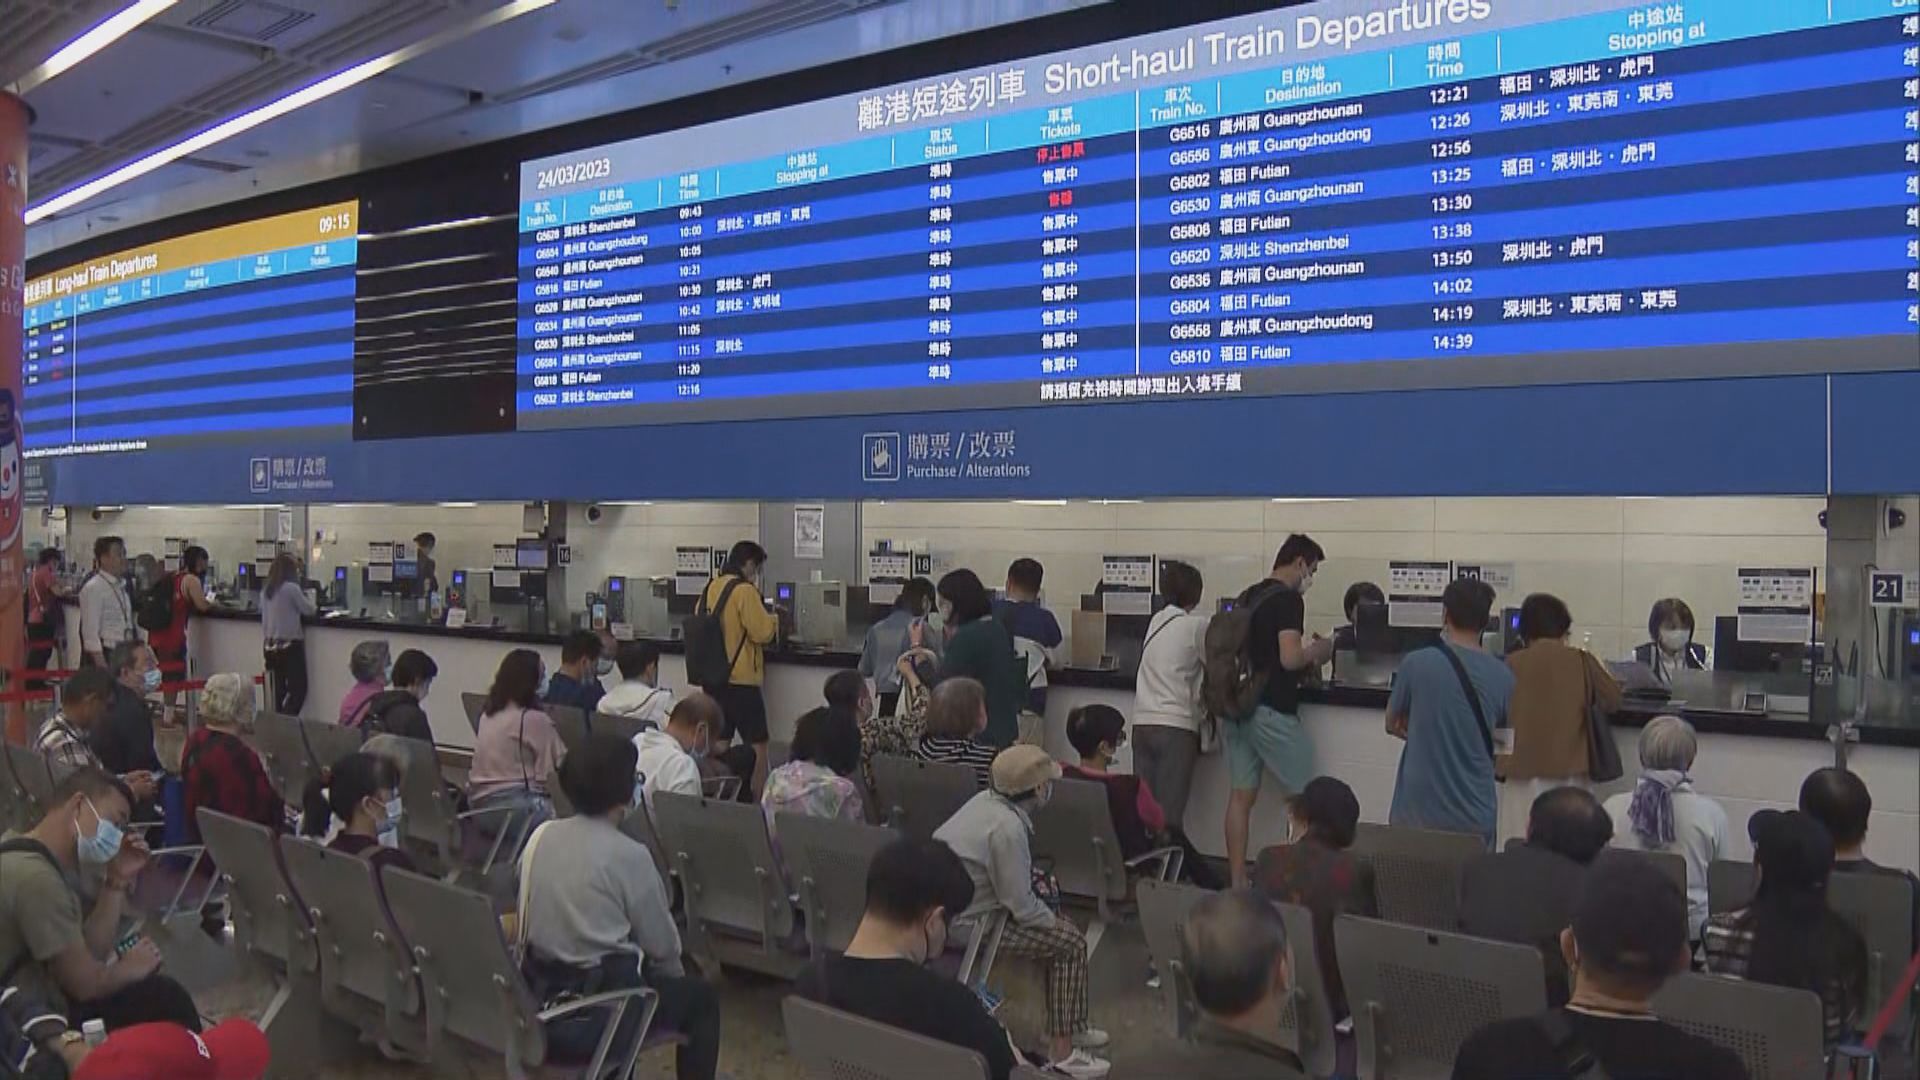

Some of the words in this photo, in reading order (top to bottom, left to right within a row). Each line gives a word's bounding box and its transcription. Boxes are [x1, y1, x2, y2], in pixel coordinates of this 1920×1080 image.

[1628, 5, 1684, 29] 中途站
[1609, 26, 1682, 51] Stopping
[1689, 21, 1705, 38] at
[1045, 39, 1193, 93] Short-haul
[1204, 26, 1284, 64] Train
[1297, 0, 1490, 49] Departures
[1428, 42, 1461, 61] 時間
[1282, 64, 1325, 85] 目的地
[1427, 62, 1464, 79] Time
[857, 69, 1026, 131] 離港短途列車
[1165, 86, 1192, 103] 車次
[1265, 81, 1341, 104] Destination
[1430, 86, 1468, 104] 12:21
[1048, 107, 1073, 123] 車票
[1151, 106, 1181, 121] Train
[1185, 102, 1206, 116] No.
[1219, 114, 1260, 136] 廣州南
[1264, 102, 1363, 128] Guangzhounan
[1431, 112, 1471, 130] 12:26
[1040, 124, 1080, 139] Tickets
[924, 145, 957, 158] Status
[1219, 140, 1260, 160] 廣州東
[1264, 127, 1371, 152] Guangzhoudong
[1431, 140, 1471, 158] 12:56
[538, 159, 610, 189] 24/03/2023
[777, 166, 816, 184] Stopping
[819, 164, 828, 177] at
[930, 162, 952, 179] 準時
[1043, 166, 1078, 185] 售票中
[1219, 167, 1247, 185] 福田
[1250, 164, 1290, 181] Futian
[1431, 168, 1471, 184] 13:25
[1170, 173, 1210, 191] G5802
[679, 188, 699, 200] Time
[930, 184, 952, 201] 準時
[1219, 190, 1260, 209] 廣州南
[1264, 181, 1364, 203] Guangzhounan
[590, 201, 633, 215] Destination
[1170, 198, 1210, 215] G6530
[1431, 194, 1472, 212] 13:30
[680, 205, 702, 219] 09:43
[930, 207, 952, 224] 準時
[319, 214, 349, 233] 09:15
[588, 216, 636, 233] Shenzhenbei
[1042, 213, 1078, 231] 售票中
[1219, 217, 1247, 235] 福田
[1251, 215, 1290, 231] Futian
[1431, 222, 1473, 239] 13:38
[681, 225, 702, 237] 10:00
[929, 229, 951, 246] 準時
[588, 235, 648, 252] Guangzhoudong
[681, 245, 701, 257] 10:05
[1042, 238, 1078, 256] 售票中
[1219, 242, 1260, 261] 深圳北
[1265, 234, 1349, 255] Shenzhenbei
[587, 256, 644, 270] Guangzhounan
[929, 251, 951, 268] 準時
[1170, 248, 1210, 265] G5620
[1432, 250, 1473, 267] 13:50
[56, 268, 88, 294] Long-haul
[89, 264, 109, 283] Train
[111, 254, 157, 279] Departures
[681, 264, 700, 277] 10:21
[1042, 261, 1078, 279] 售票中
[1219, 267, 1261, 286] 廣州南
[1265, 261, 1365, 281] Guangzhounan
[580, 279, 603, 288] Futian
[680, 285, 701, 296] 10:30
[929, 274, 951, 290] 準時
[1432, 278, 1473, 295] 14:02
[587, 294, 643, 307] Guangzhounan
[1042, 284, 1078, 302] 售票中
[680, 304, 701, 316] 10:42
[929, 296, 950, 312] 準時
[1170, 299, 1210, 315] G5804
[1219, 294, 1247, 311] 福田
[1251, 293, 1291, 308] Futian
[586, 314, 643, 326] Guangzhounan
[1042, 308, 1078, 326] 售票中
[1432, 305, 1473, 321] 14:19
[679, 324, 701, 336] 11:05
[929, 319, 950, 335] 準時
[1219, 319, 1261, 337] 廣州東
[1265, 313, 1373, 333] Guangzhoudong
[586, 332, 635, 344] Shenzhenbei
[716, 339, 743, 353] 深圳北
[1042, 331, 1078, 349] 售票中
[1433, 333, 1473, 349] 14:39
[679, 344, 700, 356] 11:15
[929, 342, 950, 357] 準時
[1170, 350, 1211, 365] G5810
[1219, 345, 1247, 362] 福田
[1251, 345, 1291, 359] Futian
[586, 353, 642, 364] Guangzhounan
[1042, 356, 1078, 374] 售票中
[578, 373, 602, 382] Futian
[679, 363, 701, 375] 11:20
[928, 364, 950, 380] 準時
[586, 390, 634, 400] Shenzhenbei
[679, 383, 700, 395] 12:16
[907, 463, 956, 478] Purchase
[966, 463, 1030, 478] Alterations
[560, 549, 570, 561] 16
[916, 554, 930, 573] 18
[1875, 579, 1898, 598] 21
